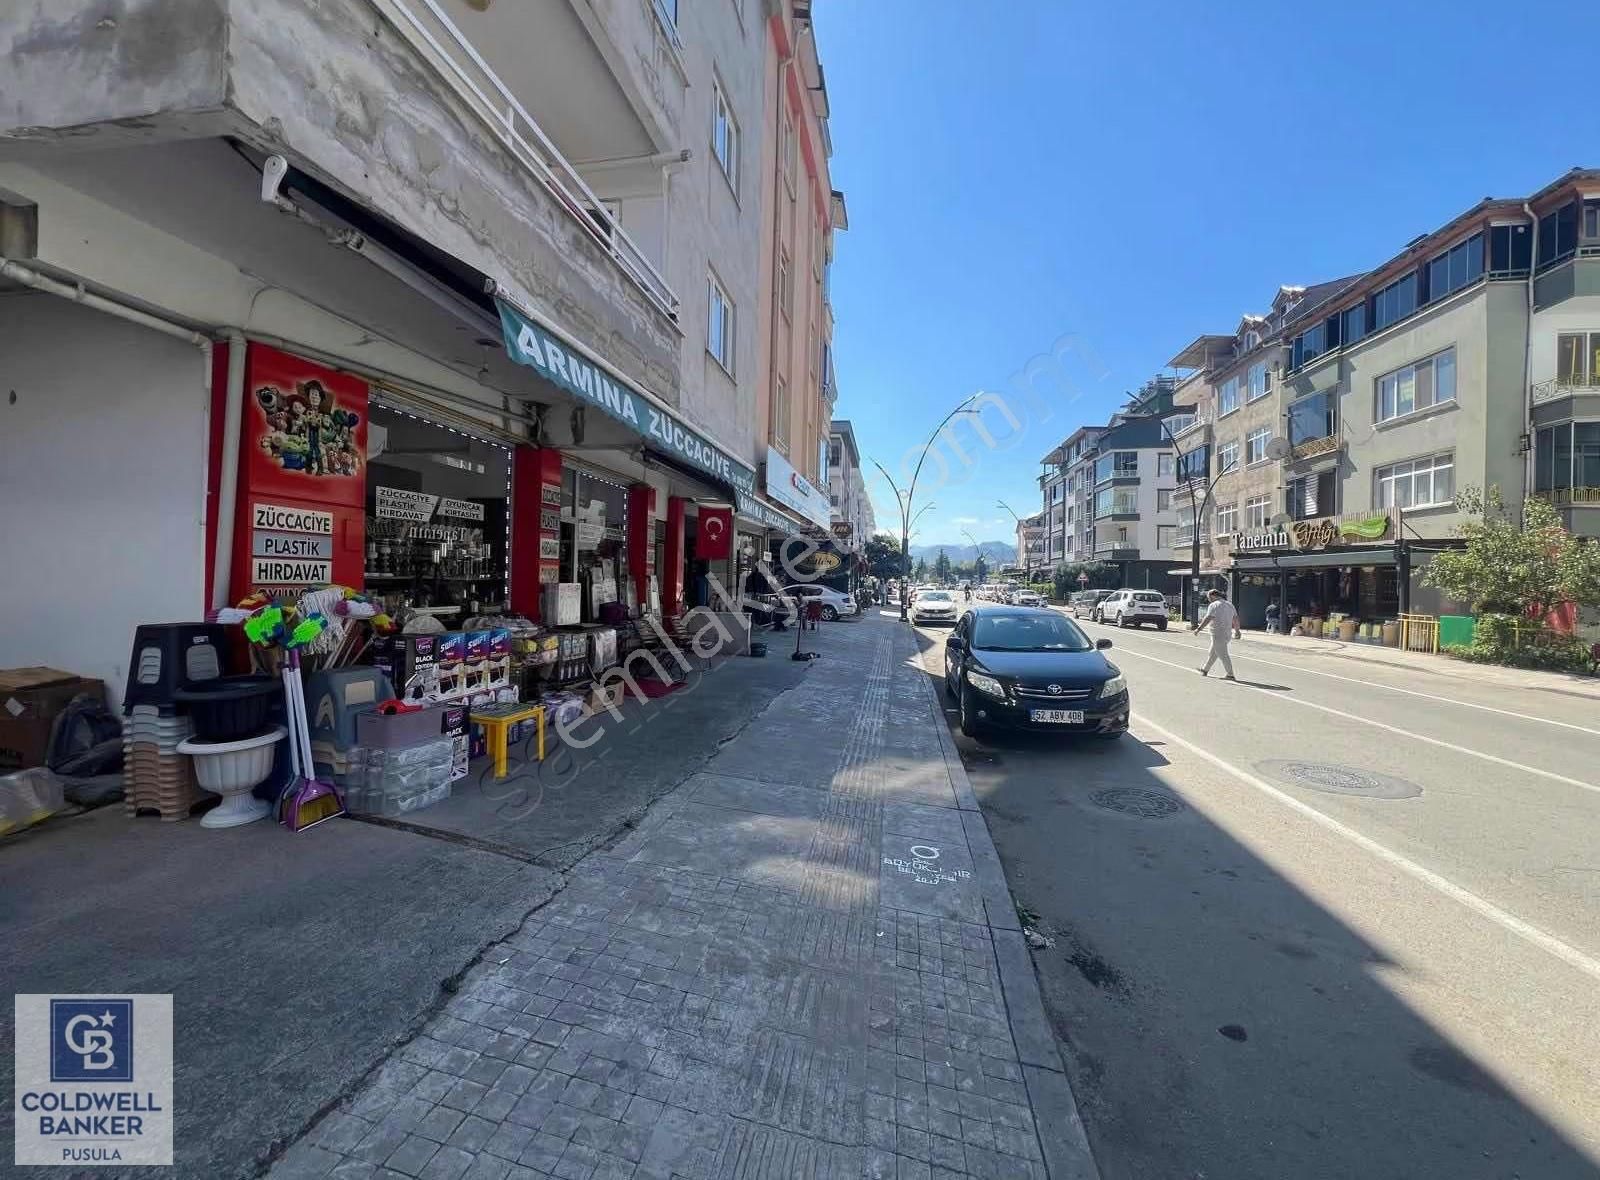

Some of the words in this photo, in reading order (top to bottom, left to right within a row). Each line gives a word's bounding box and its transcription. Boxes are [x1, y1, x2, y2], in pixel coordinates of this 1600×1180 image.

[517, 323, 638, 425] ARMİNA
[648, 408, 730, 478] ZÜCCACİYE
[256, 507, 331, 532] ZÜCCACİYE
[379, 508, 425, 520] HIRDAVAT
[264, 537, 320, 556] PLASTİK
[257, 562, 327, 581] HIRDAVAT
[415, 655, 434, 663] BLACK
[1036, 710, 1046, 720] 52
[1067, 710, 1083, 720] 408
